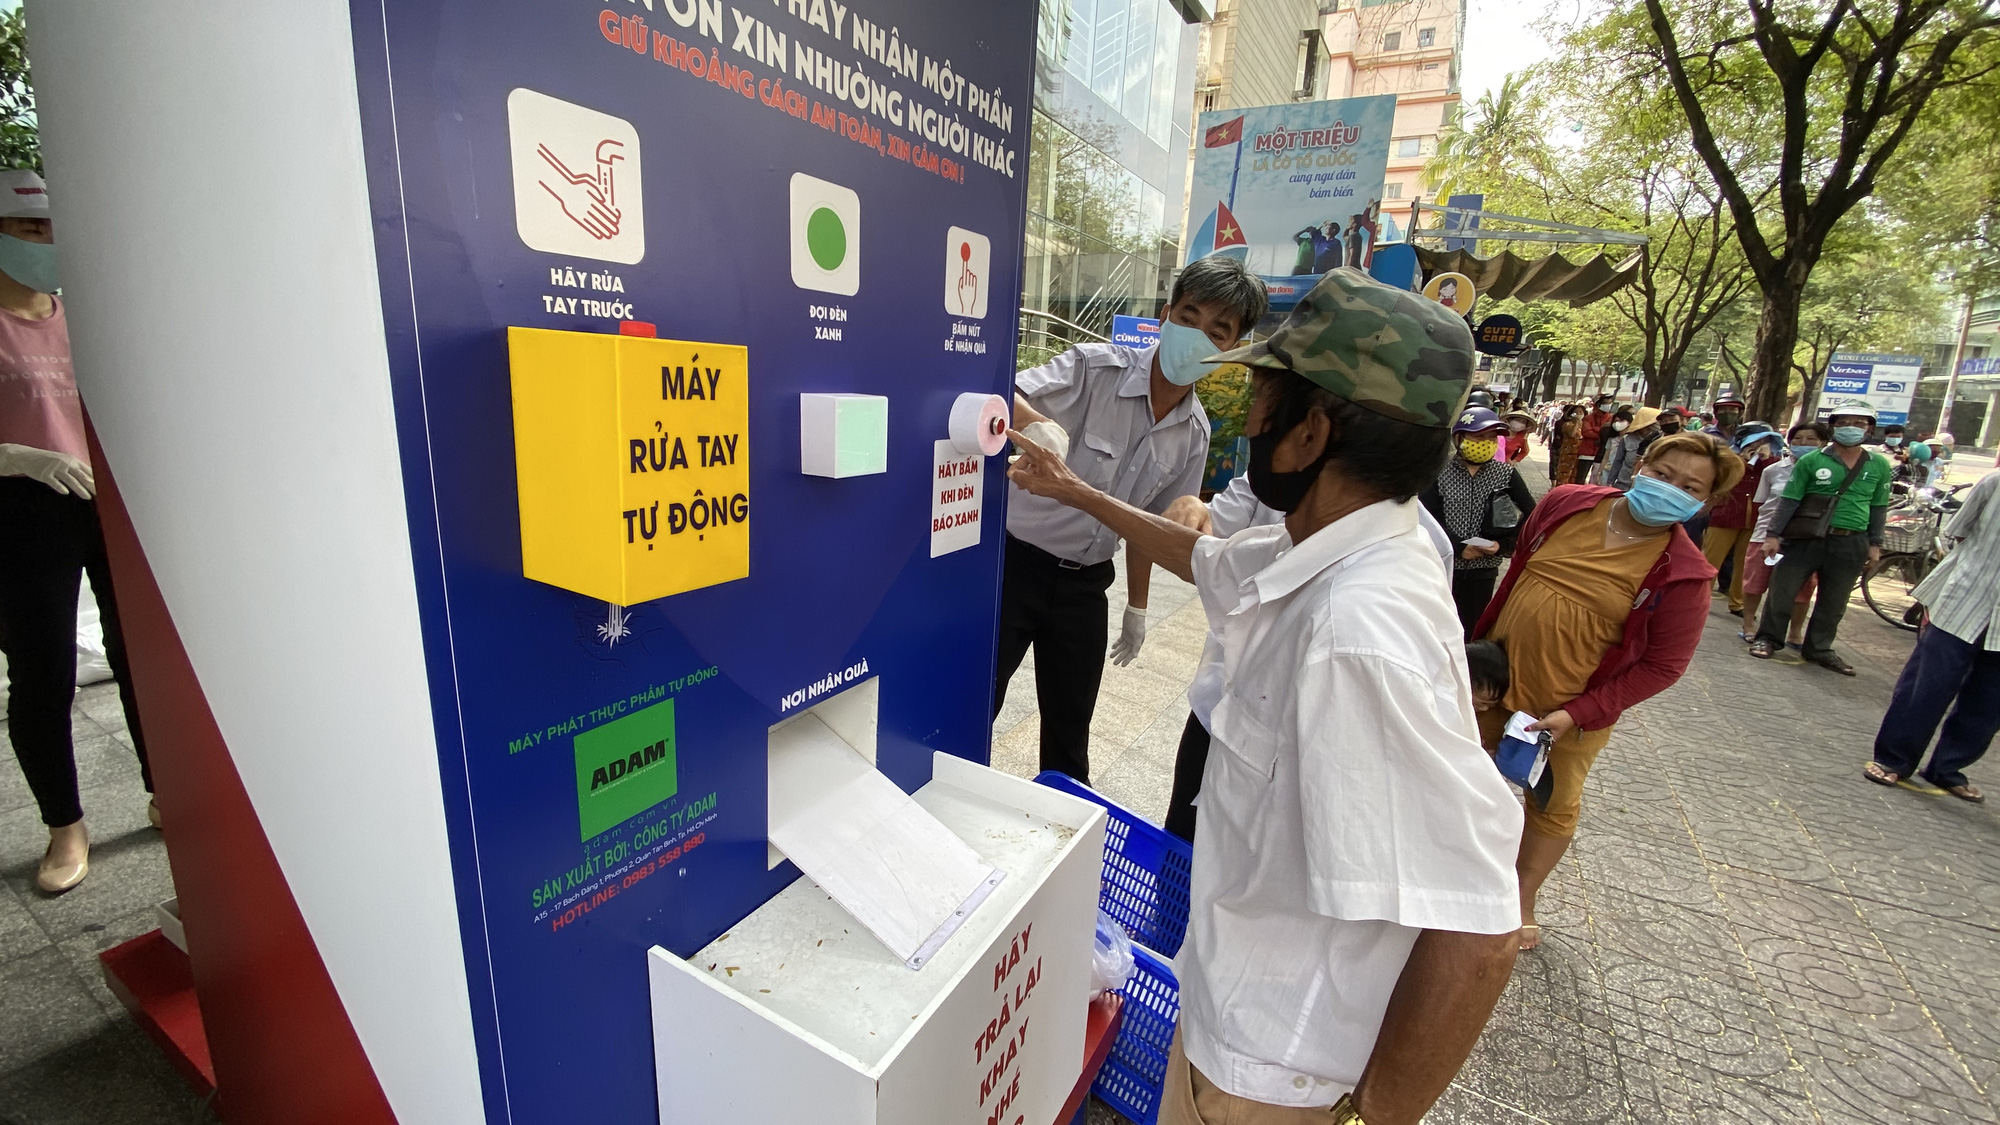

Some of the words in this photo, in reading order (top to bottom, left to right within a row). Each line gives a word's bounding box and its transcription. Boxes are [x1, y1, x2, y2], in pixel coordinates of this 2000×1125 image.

[853, 13, 918, 82] NHẬN
[922, 56, 965, 106] MỘT
[968, 82, 1012, 134] PHẦN
[599, 9, 648, 54] GIỮ
[652, 30, 755, 99] KHOẢNG
[759, 78, 807, 120] CÁCH
[811, 101, 836, 132] AN
[838, 111, 885, 157] TOÀN,
[887, 133, 910, 163] XIN
[912, 143, 939, 175] CẢM
[731, 7, 787, 73] XIN
[795, 40, 903, 126] NHƯỜNG
[908, 99, 969, 157] NGƯỜI
[972, 132, 1015, 179] KHÁC
[1255, 125, 1298, 155] MỘT
[1300, 121, 1359, 151] TRIỆU
[1253, 156, 1269, 171] LÁ
[1272, 155, 1292, 170] CỜ
[1316, 149, 1358, 168] QUỐC
[1289, 172, 1313, 185] cùng
[1314, 171, 1335, 184] ngư
[1336, 169, 1356, 180] dân
[1309, 187, 1331, 198] bám
[550, 266, 587, 288] HÃY
[591, 270, 625, 293] RỬA
[542, 295, 578, 315] TAY
[581, 298, 634, 320] TRƯỚC
[809, 304, 827, 321] ĐỢI
[829, 305, 847, 322] ĐÈN
[815, 326, 842, 341] XANH
[952, 319, 967, 335] BẤM
[968, 323, 981, 338] NÚT
[1115, 333, 1140, 343] CÙNG
[1482, 334, 1514, 343] CAFE
[1484, 326, 1516, 335] GUTA
[944, 335, 954, 351] ĐỂ
[955, 339, 973, 355] NHẬN
[974, 340, 986, 355] QUÀ
[661, 352, 721, 401] MÁY
[1827, 379, 1865, 388] brother
[1831, 366, 1870, 375] Virbac
[629, 420, 689, 474] RỬA
[697, 433, 739, 468] TAY
[938, 460, 957, 479] HÃY
[959, 455, 978, 475] BẤM
[940, 489, 956, 505] KHI
[957, 483, 974, 501] ĐÈN
[622, 500, 659, 551] TỰ
[668, 489, 748, 541] ĐỘNG
[933, 513, 953, 533] BÁO
[954, 509, 979, 527] XANH
[781, 688, 806, 713] NƠI
[808, 671, 842, 699] NHẬN
[844, 657, 869, 682] QUÀ
[508, 729, 543, 755] MÁY
[547, 714, 586, 741] PHÁT
[589, 699, 626, 724] THỰC
[630, 684, 665, 709] PHẨM
[668, 677, 685, 693] TỰ
[686, 665, 719, 687] ĐỘNG
[590, 739, 666, 792] ADAM
[532, 877, 562, 908] SẢN
[565, 853, 602, 891] XUẤT
[604, 839, 631, 869] BỞI:
[634, 819, 668, 850] CÔNG
[670, 808, 684, 830] TY
[686, 791, 717, 822] ADAM
[534, 910, 548, 924] A15
[704, 812, 718, 824] Minh
[552, 884, 620, 932] HOTLINE:
[622, 861, 655, 889] 0983
[658, 846, 681, 869] 558
[683, 831, 705, 853] 880
[993, 921, 1033, 993] HÃY
[974, 993, 1011, 1065] TRẢ
[1014, 955, 1042, 1013] LẠI
[979, 1015, 1029, 1108] KHAY
